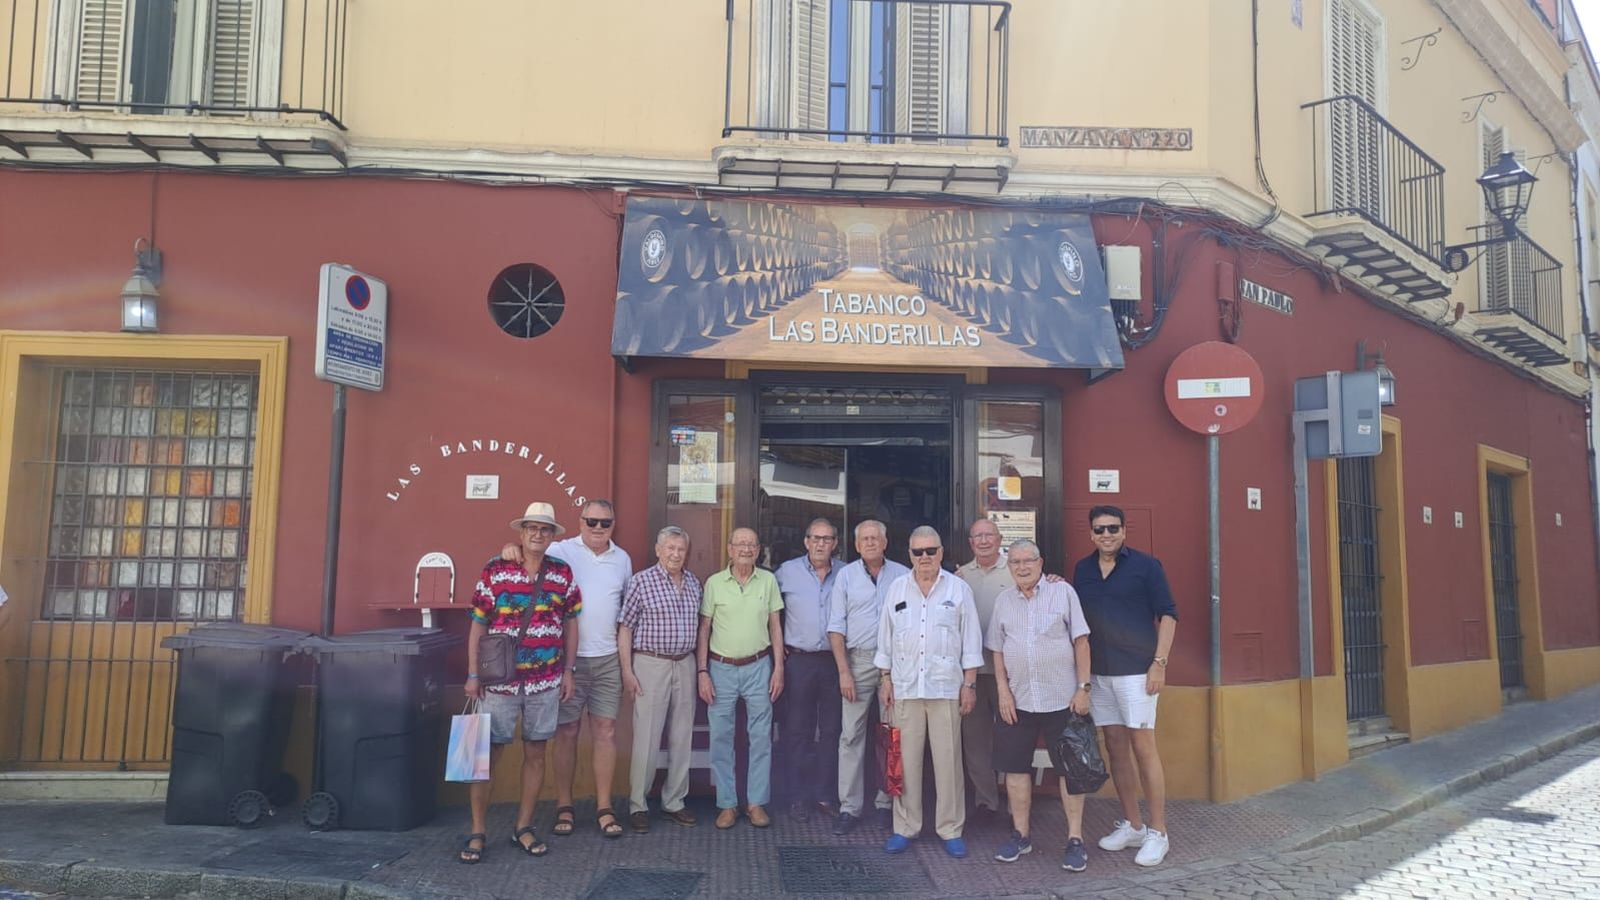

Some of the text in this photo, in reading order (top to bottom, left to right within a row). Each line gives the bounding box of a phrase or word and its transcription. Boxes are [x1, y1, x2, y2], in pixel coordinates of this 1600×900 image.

[1022, 129, 1123, 147] MANZANA
[817, 287, 928, 317] TABANCO
[768, 315, 983, 348] LAS BANDERILLAS
[386, 438, 587, 508] LAS BANDERILLAS
